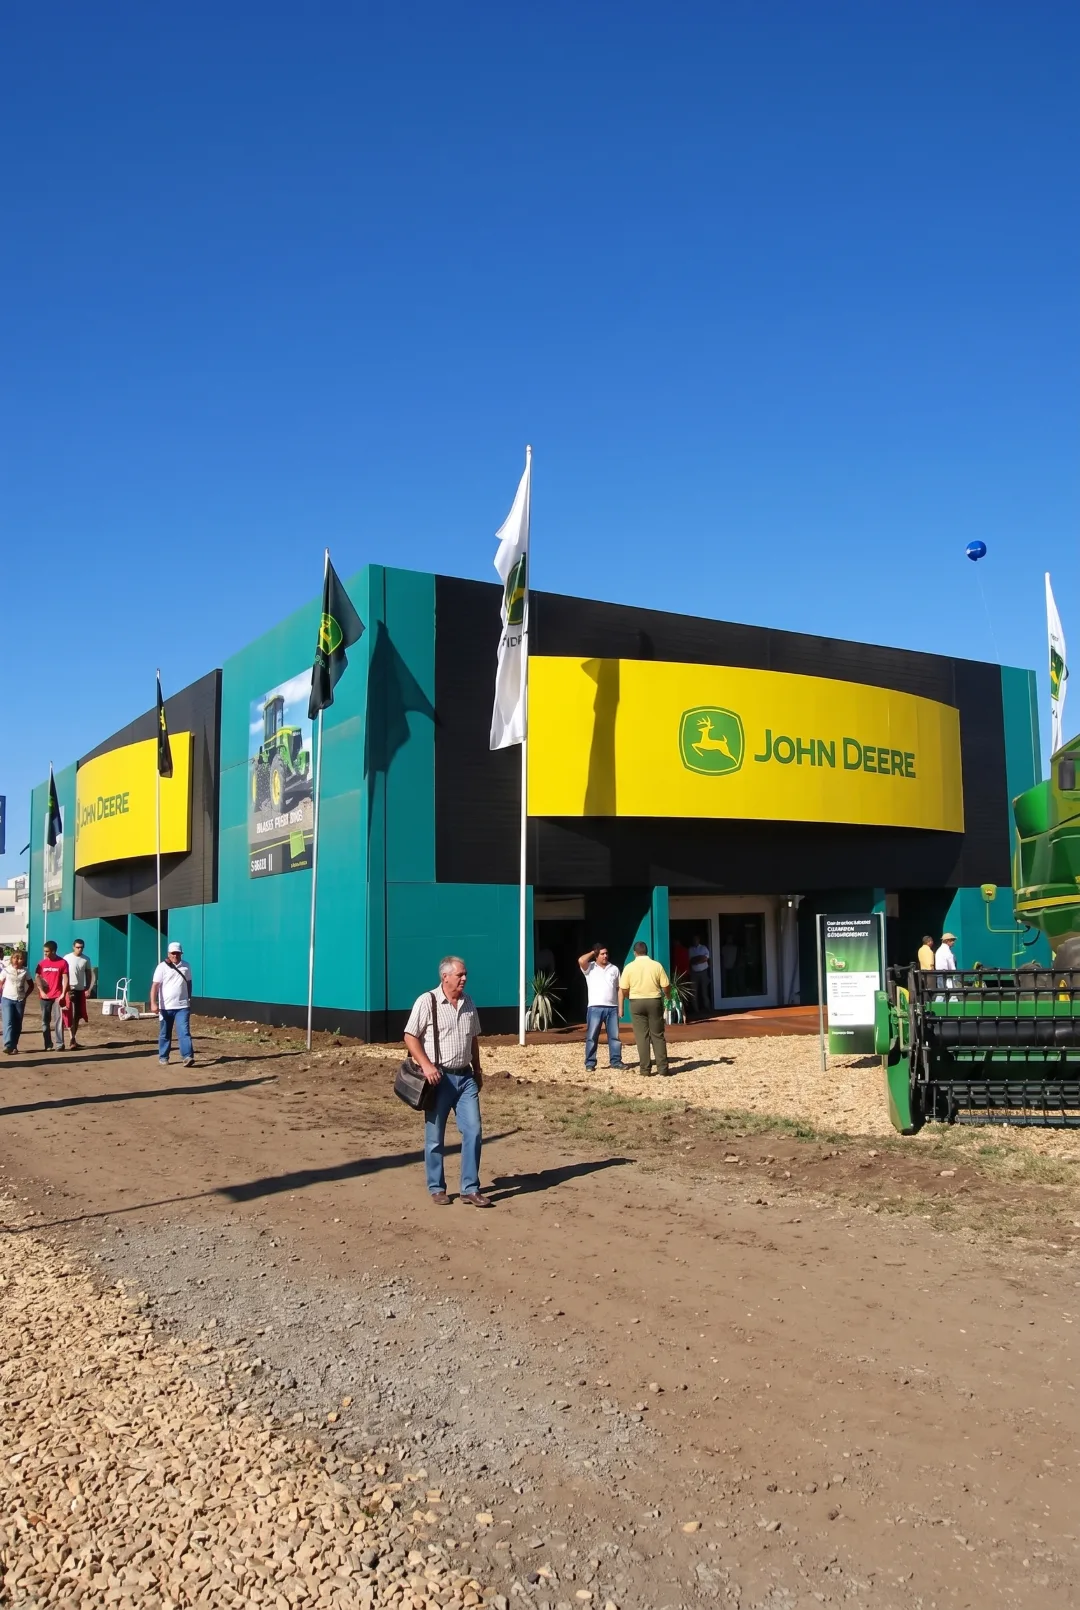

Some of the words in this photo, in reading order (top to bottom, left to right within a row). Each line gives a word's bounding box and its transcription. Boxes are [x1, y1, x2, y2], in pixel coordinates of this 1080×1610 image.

[754, 729, 836, 768] JOHN
[843, 737, 916, 778] DEERE
[97, 791, 130, 821] DEERE
